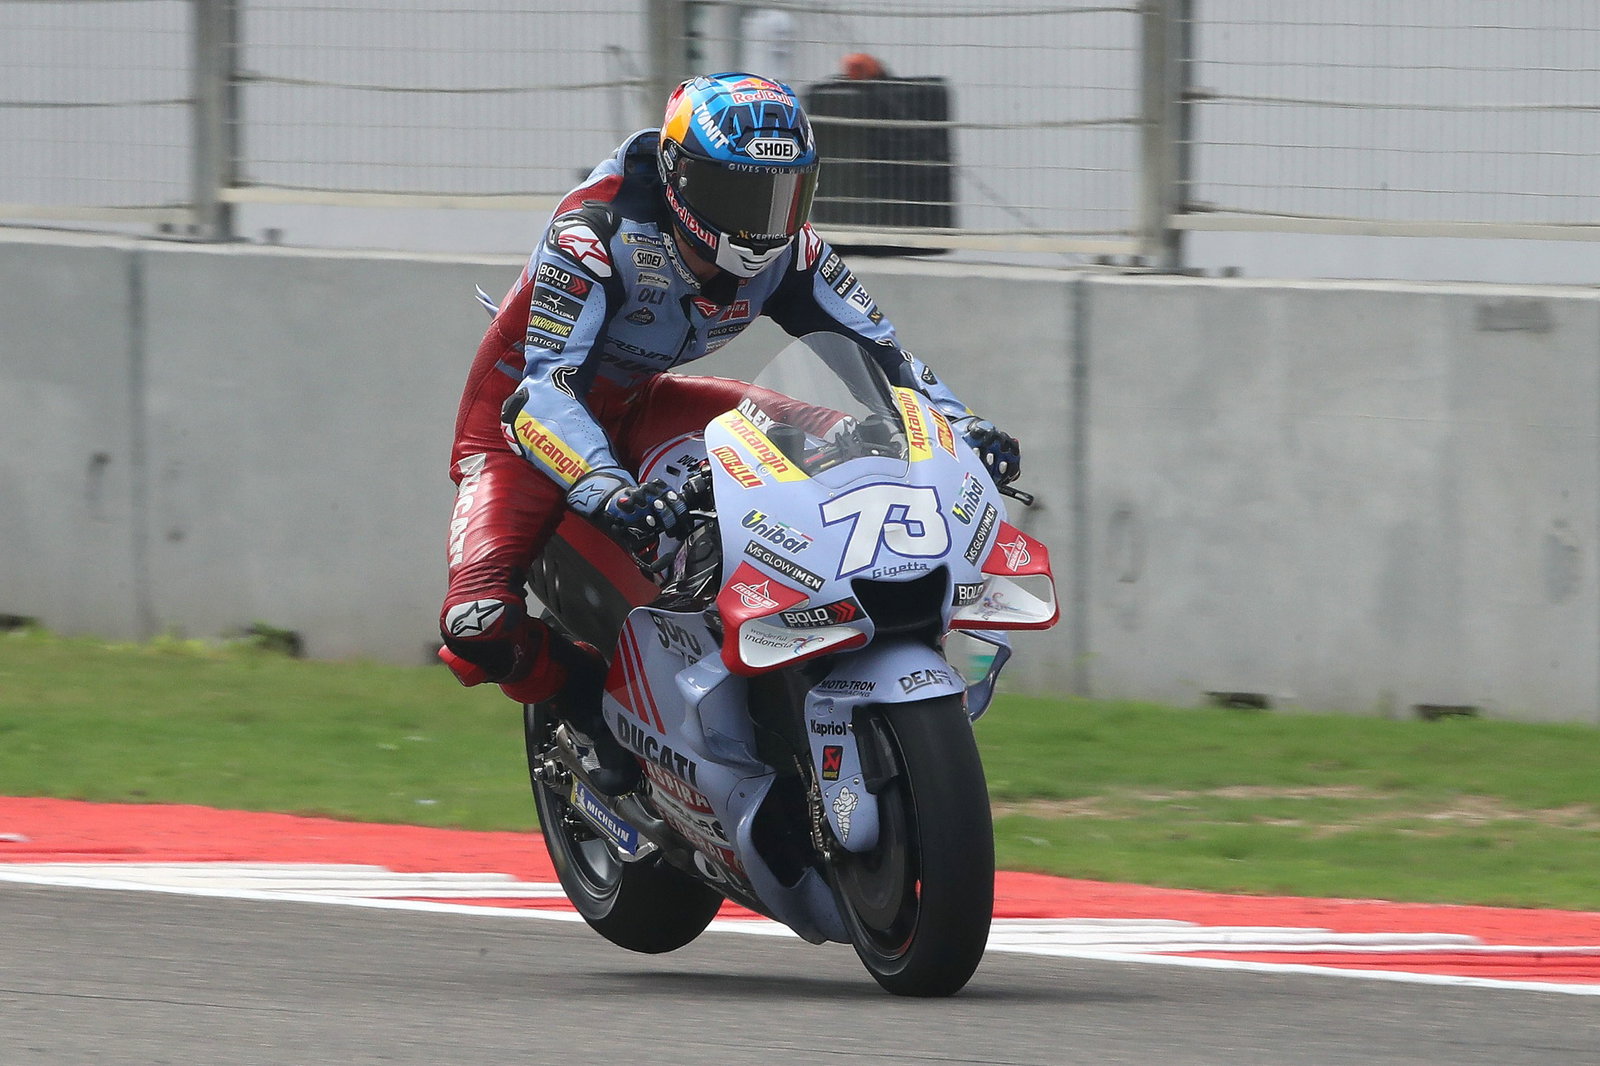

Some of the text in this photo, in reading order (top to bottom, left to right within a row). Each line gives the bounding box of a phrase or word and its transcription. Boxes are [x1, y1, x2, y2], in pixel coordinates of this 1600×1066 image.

[731, 90, 793, 107] Red Bull
[755, 143, 793, 157] SHOEI
[728, 163, 760, 173] GIVES
[666, 184, 717, 250] Red Bull
[637, 252, 661, 267] SHOEI
[821, 253, 840, 279] BOLD
[540, 264, 570, 284] BOLD
[709, 327, 727, 337] POLO
[738, 397, 774, 434] ALEX
[900, 391, 927, 452] Antangin
[516, 420, 587, 482] Antangin
[727, 415, 788, 473] Antangin
[953, 475, 984, 526] Unibat
[742, 509, 808, 554] Unibat
[819, 482, 952, 581] 73
[965, 548, 978, 562] MS
[973, 526, 988, 550] GLOW
[747, 541, 763, 558] MS
[762, 553, 794, 573] GLOW
[872, 561, 930, 579] Gigetta
[736, 585, 765, 602] FEDERAL
[785, 608, 829, 624] BOLD
[745, 634, 793, 648] indonesia
[751, 628, 787, 641] wonderful
[819, 680, 876, 691] MOTO-TRON
[810, 719, 847, 736] Kapriol
[617, 712, 699, 788] DUCATI
[645, 760, 709, 808] ASPIRA
[586, 801, 630, 843] MICHELIN
